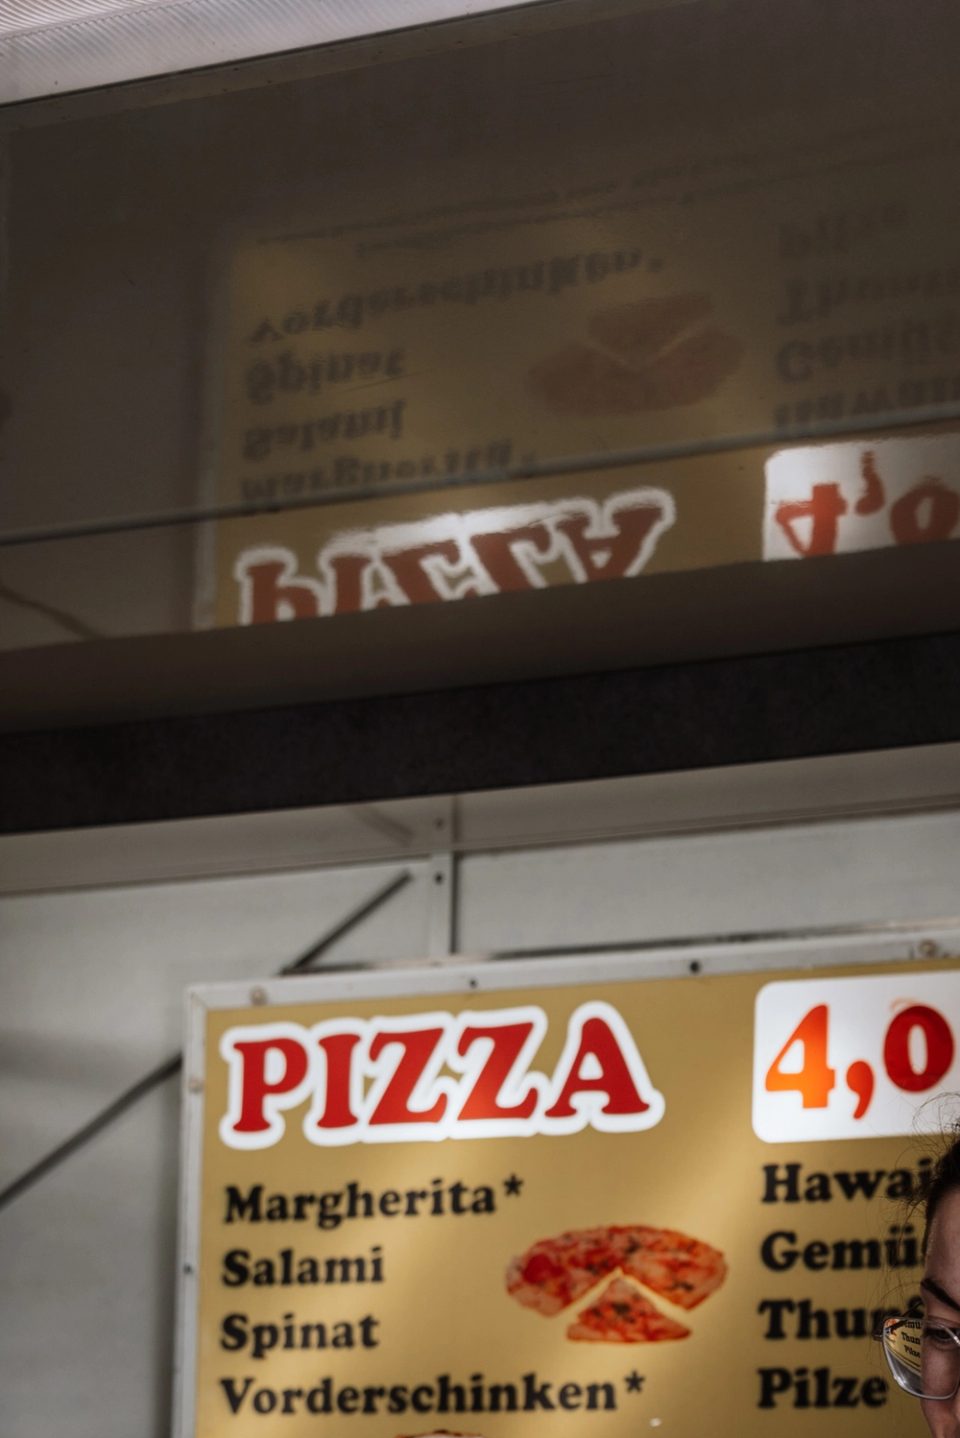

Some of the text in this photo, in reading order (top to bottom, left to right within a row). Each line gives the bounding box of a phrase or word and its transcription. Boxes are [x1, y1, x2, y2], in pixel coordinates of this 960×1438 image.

[229, 1014, 653, 1135] PIZZA
[762, 1158, 934, 1203] Hawai
[221, 1245, 385, 1288] Salami
[760, 1225, 926, 1273] Gemü
[219, 1313, 381, 1361] Spinat
[757, 1366, 889, 1408] Pilze
